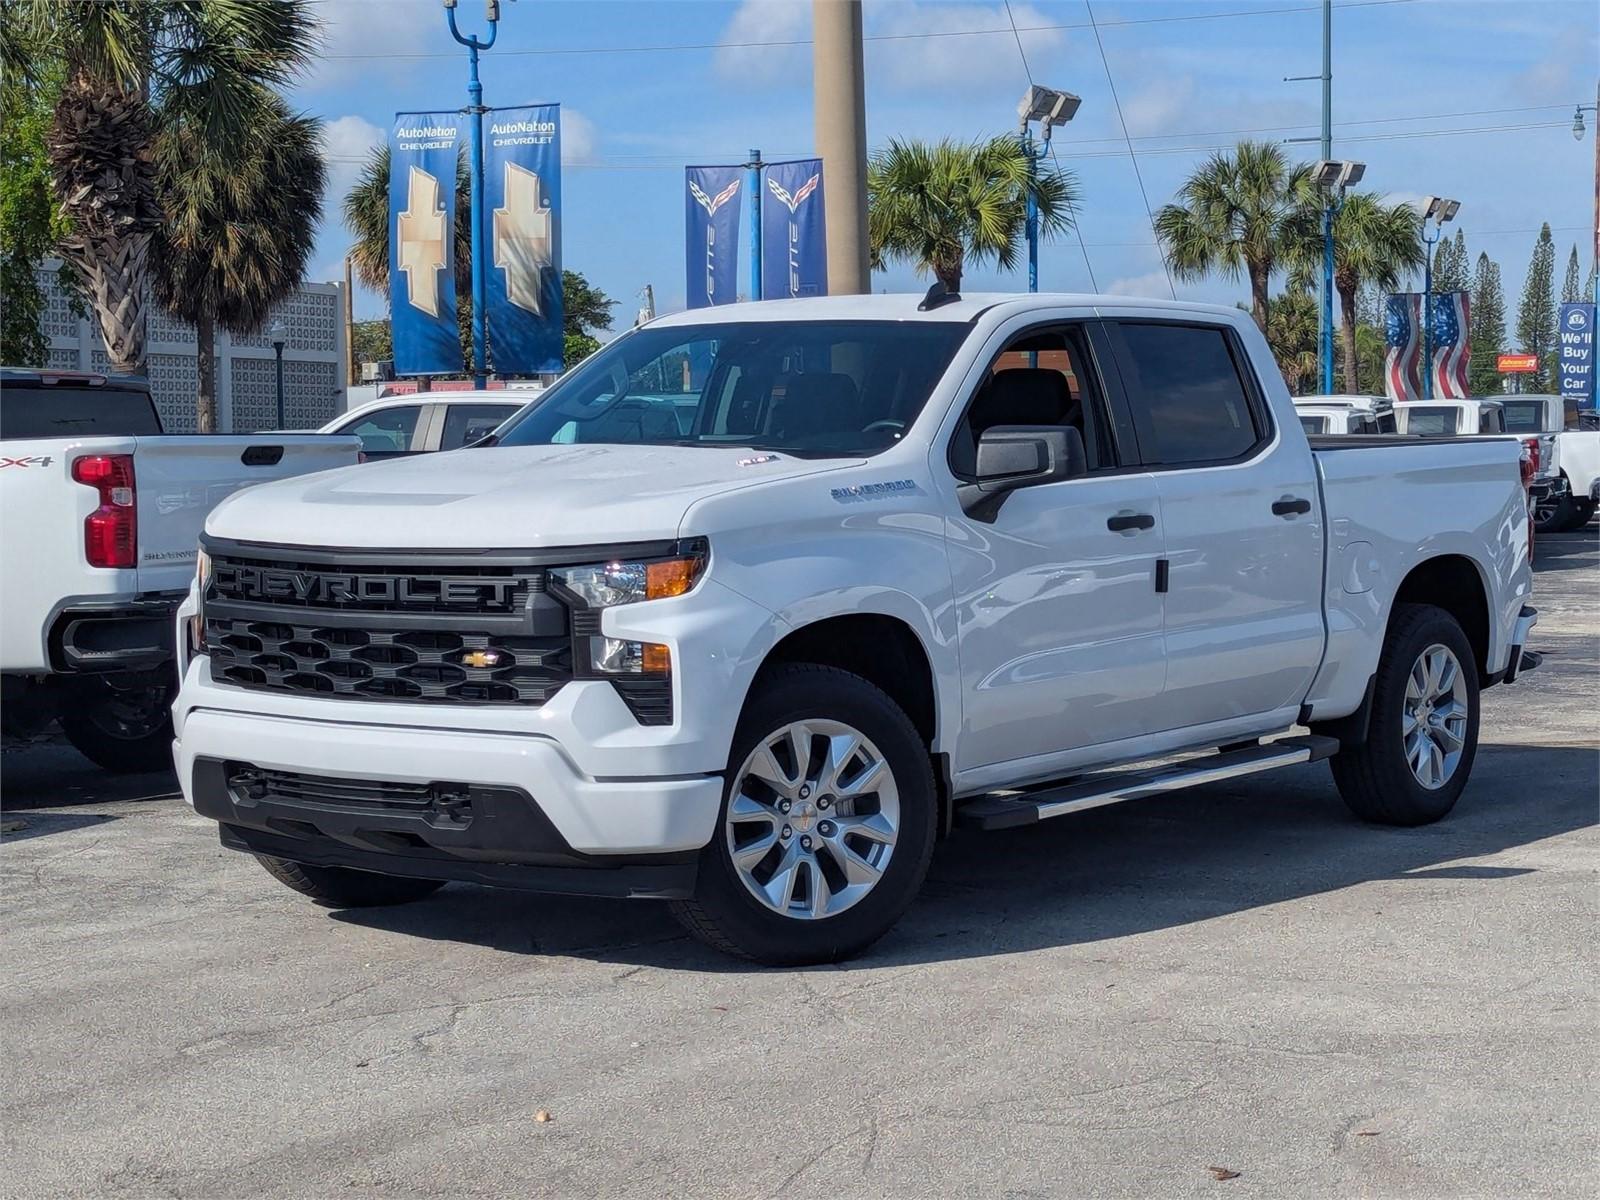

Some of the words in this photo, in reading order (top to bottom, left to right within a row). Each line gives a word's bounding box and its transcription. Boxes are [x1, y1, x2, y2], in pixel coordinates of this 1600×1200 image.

[397, 127, 457, 139] AutoNation
[490, 121, 555, 135] AutoNation
[400, 141, 453, 151] CHEVROLET
[493, 136, 553, 147] CHEVROLET
[1561, 333, 1592, 344] We'll
[1563, 347, 1589, 360] Buy
[1561, 363, 1590, 374] Your
[1563, 378, 1586, 389] Car
[212, 566, 519, 606] CHEVROLET
